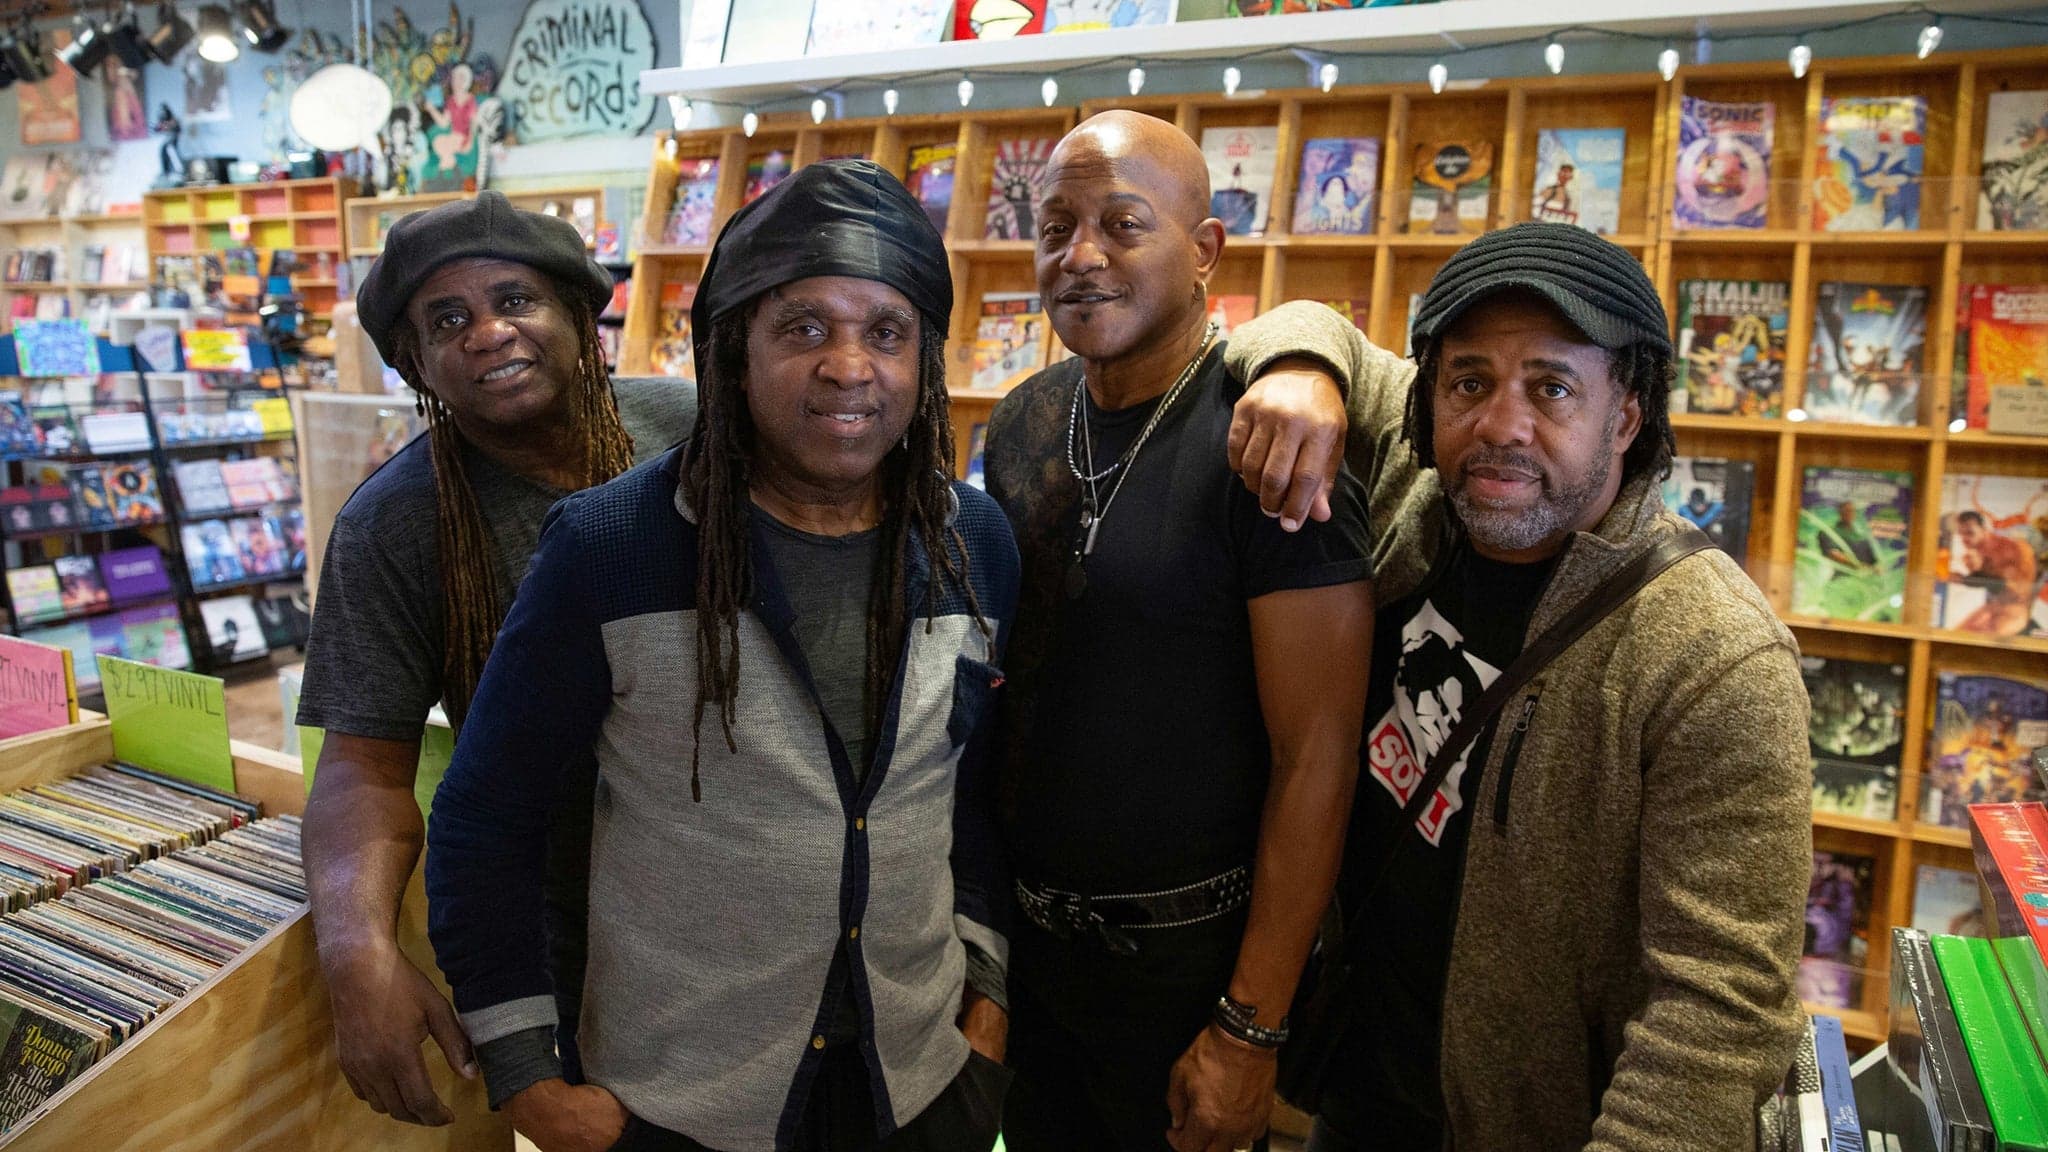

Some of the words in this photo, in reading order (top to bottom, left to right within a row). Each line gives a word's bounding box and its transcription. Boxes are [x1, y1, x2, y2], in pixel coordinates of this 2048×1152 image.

[1697, 104, 1763, 121] SONIC
[14, 665, 65, 713] VINYL
[161, 673, 221, 717] VINYL
[1369, 734, 1437, 831] SOL
[20, 1046, 67, 1077] Fargo
[24, 1023, 74, 1063] Donna
[7, 1071, 50, 1110] Happi
[26, 1064, 52, 1092] The
